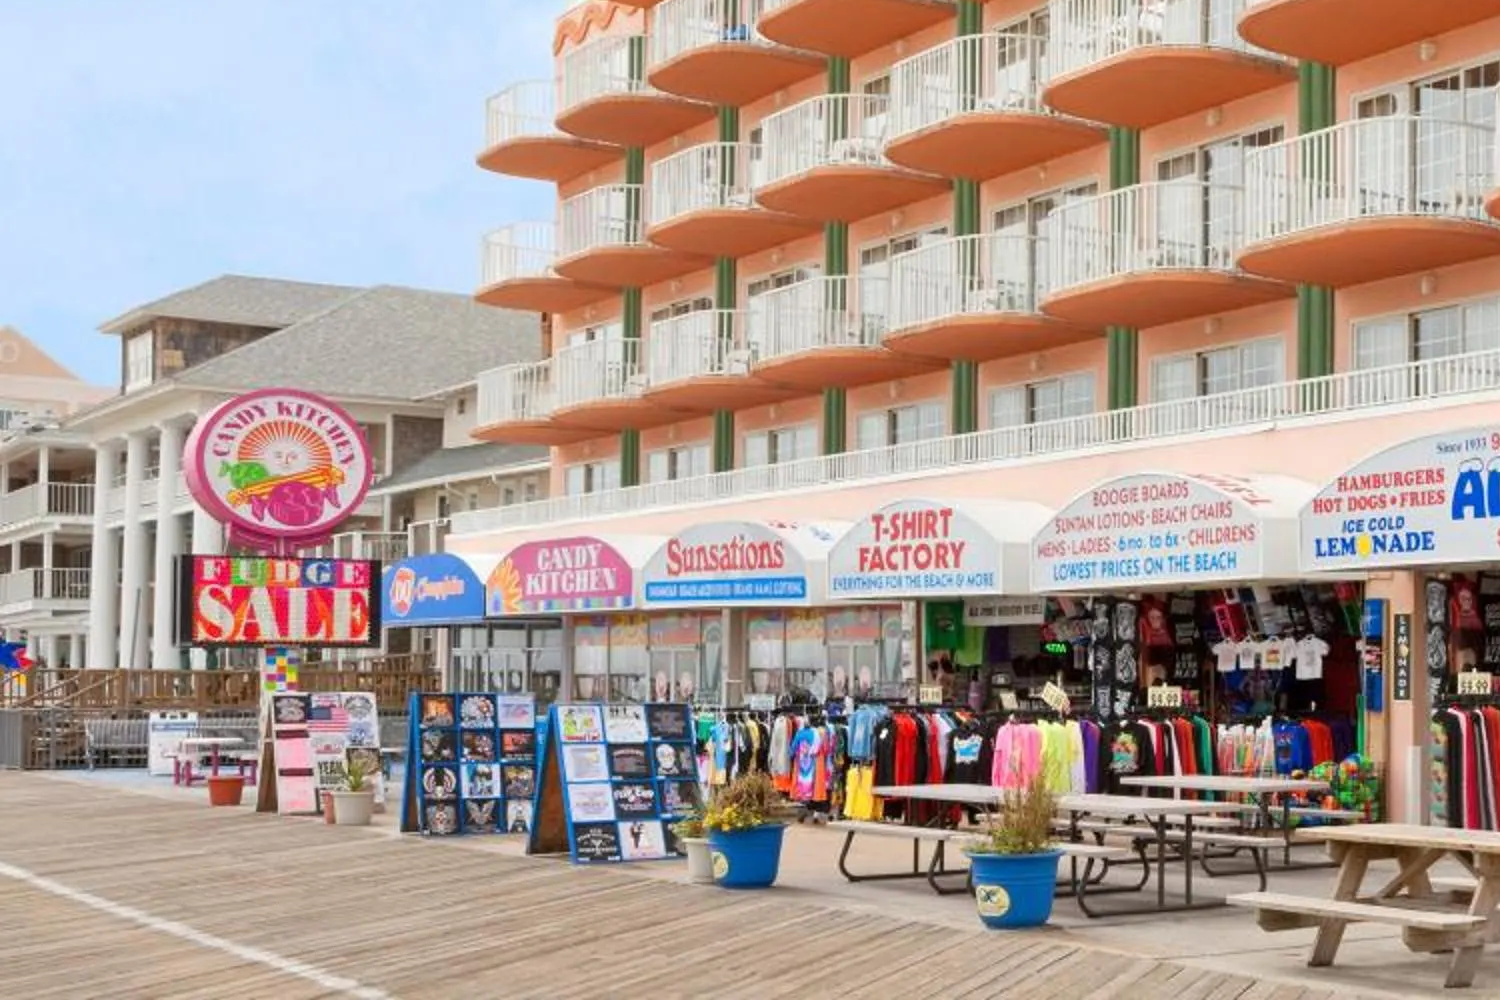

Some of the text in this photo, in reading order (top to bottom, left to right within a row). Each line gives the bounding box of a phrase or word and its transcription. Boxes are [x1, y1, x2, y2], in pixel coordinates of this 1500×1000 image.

[212, 401, 356, 465] CANDY KITCHEN
[1337, 468, 1445, 492] HAMBURGERS
[1093, 487, 1138, 507] BOOGIE
[1142, 481, 1189, 501] BOARDS
[1313, 490, 1445, 514] HOT DOGS FRIES
[872, 508, 953, 541] T-SHIRT
[1055, 501, 1233, 534] SUNTAN LOTIONS BEACH CHAIRS
[1342, 516, 1404, 533] ICE COLD
[1149, 532, 1161, 548] to
[1187, 523, 1257, 547] CHILDRENS
[537, 544, 602, 570] CANDY
[667, 535, 784, 576] Sunsations
[859, 542, 965, 572] FACTORY
[1053, 551, 1237, 581] LOWEST PRICES ON THE BEACH
[202, 560, 366, 585] FUDGE
[526, 567, 616, 595] KITCHEN
[833, 575, 883, 591] EVERYTHING
[886, 575, 902, 589] FOR
[906, 574, 922, 588] THE
[924, 573, 952, 588] BEACH
[967, 571, 994, 586] MORE
[197, 584, 369, 641] SALE
